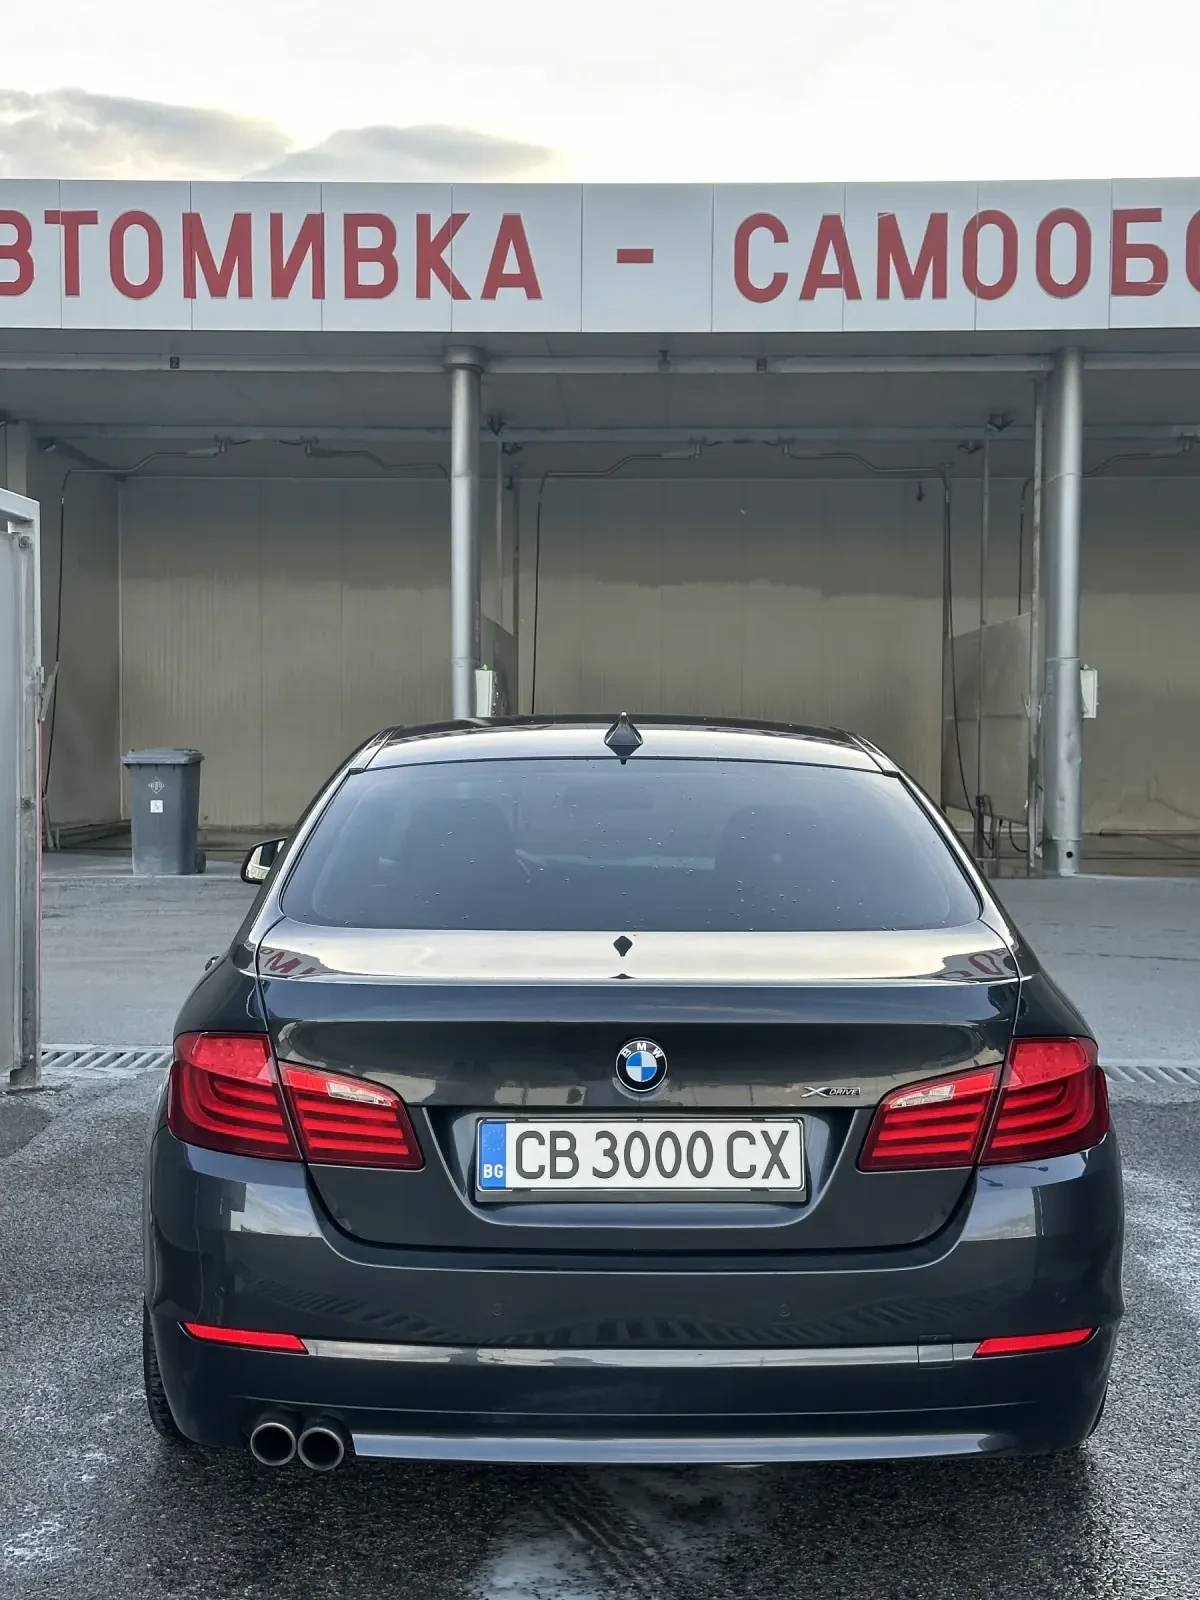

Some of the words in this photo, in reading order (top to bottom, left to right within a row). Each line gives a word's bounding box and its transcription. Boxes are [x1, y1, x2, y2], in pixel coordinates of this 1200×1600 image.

[0, 210, 540, 300] ВТОМИВКА
[735, 210, 1200, 302] САМООБ
[620, 1042, 663, 1058] BMW
[483, 1164, 504, 1178] BG
[516, 1131, 579, 1179] CB
[593, 1131, 713, 1178] 3000
[727, 1131, 790, 1179] CX
